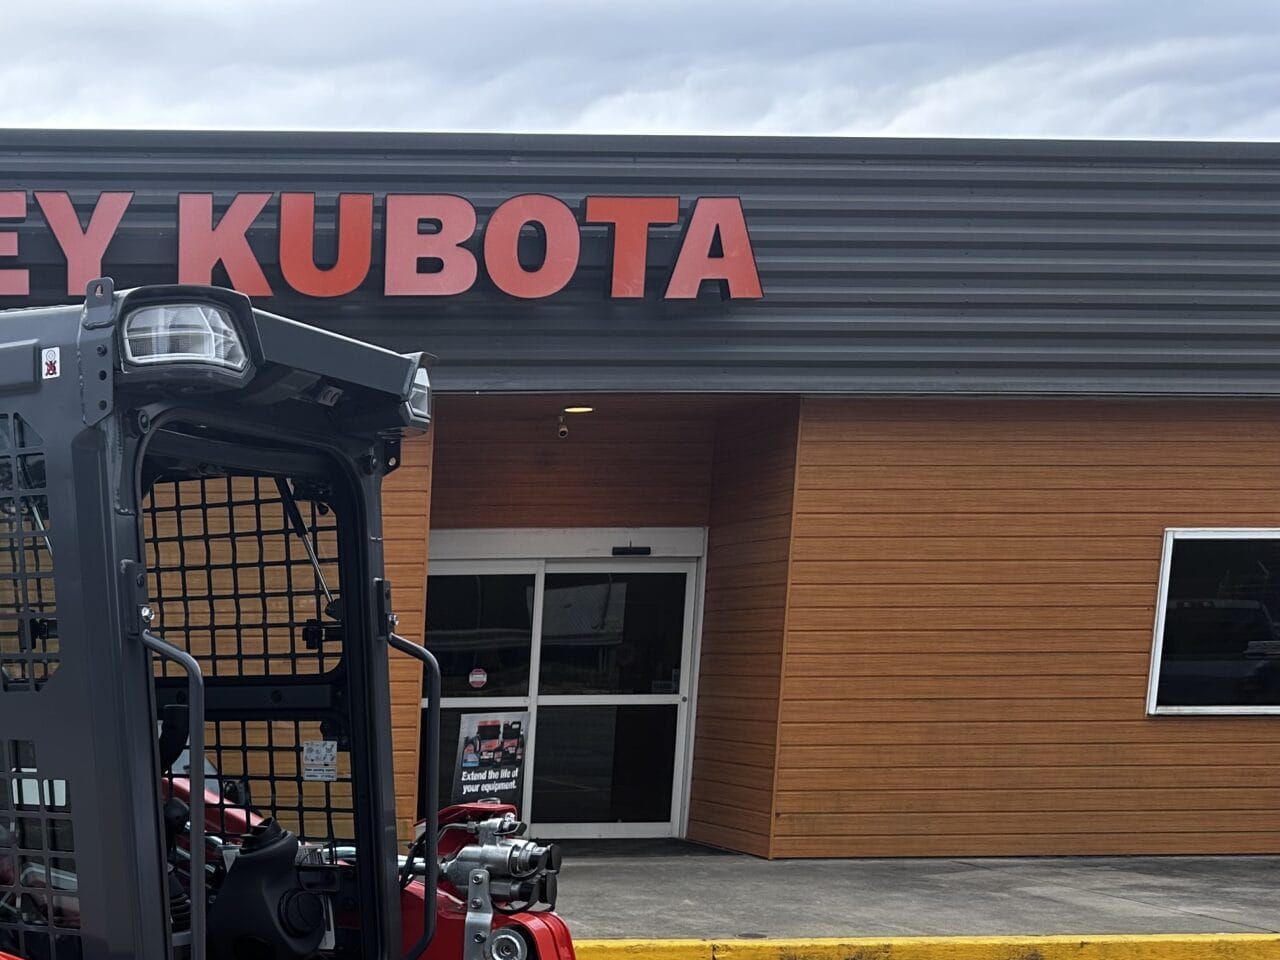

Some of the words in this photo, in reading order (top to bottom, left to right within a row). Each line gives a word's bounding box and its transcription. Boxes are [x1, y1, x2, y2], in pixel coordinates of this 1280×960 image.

[178, 192, 765, 298] KUBOTA
[461, 770, 487, 782] Extend
[488, 769, 500, 779] the
[500, 768, 511, 778] life
[511, 767, 519, 778] of
[462, 783, 480, 795] your
